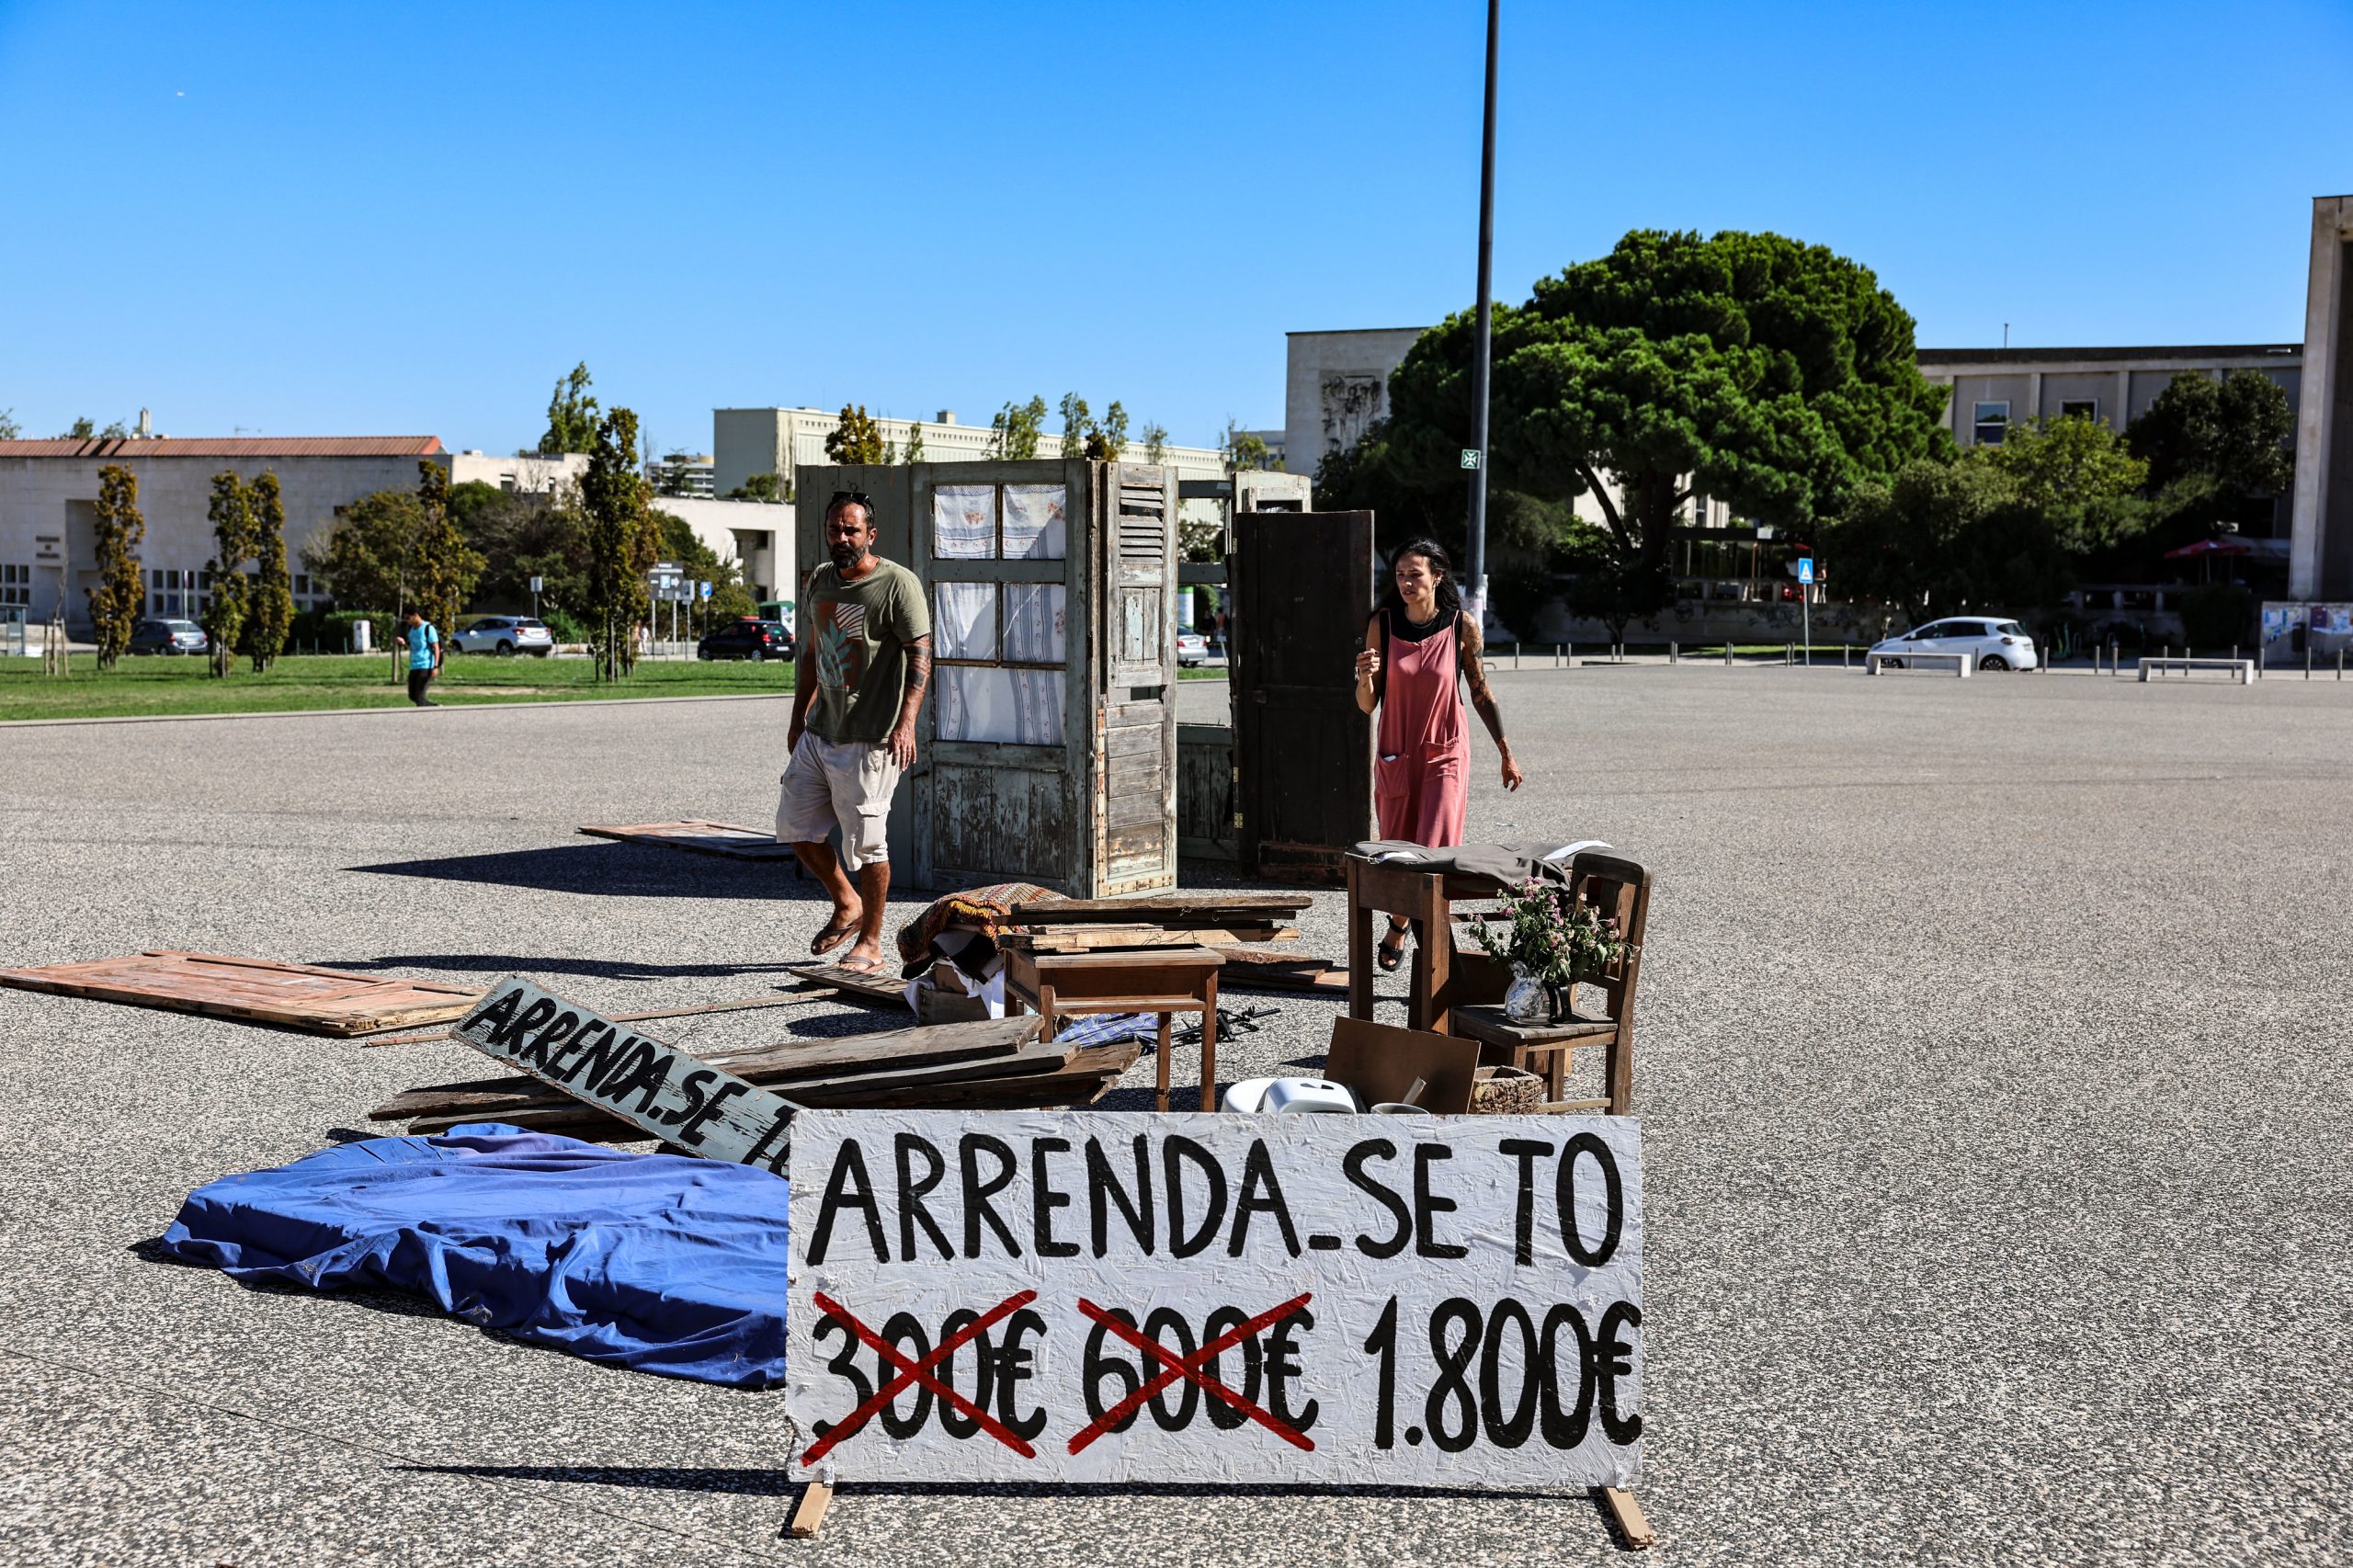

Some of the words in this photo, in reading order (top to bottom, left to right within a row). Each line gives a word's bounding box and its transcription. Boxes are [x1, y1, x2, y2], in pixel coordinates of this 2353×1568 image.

[1499, 1132, 1622, 1267] TO
[809, 1305, 1047, 1443] 300€
[1081, 1304, 1318, 1437] 600€
[1364, 1295, 1642, 1452] 1.800€
